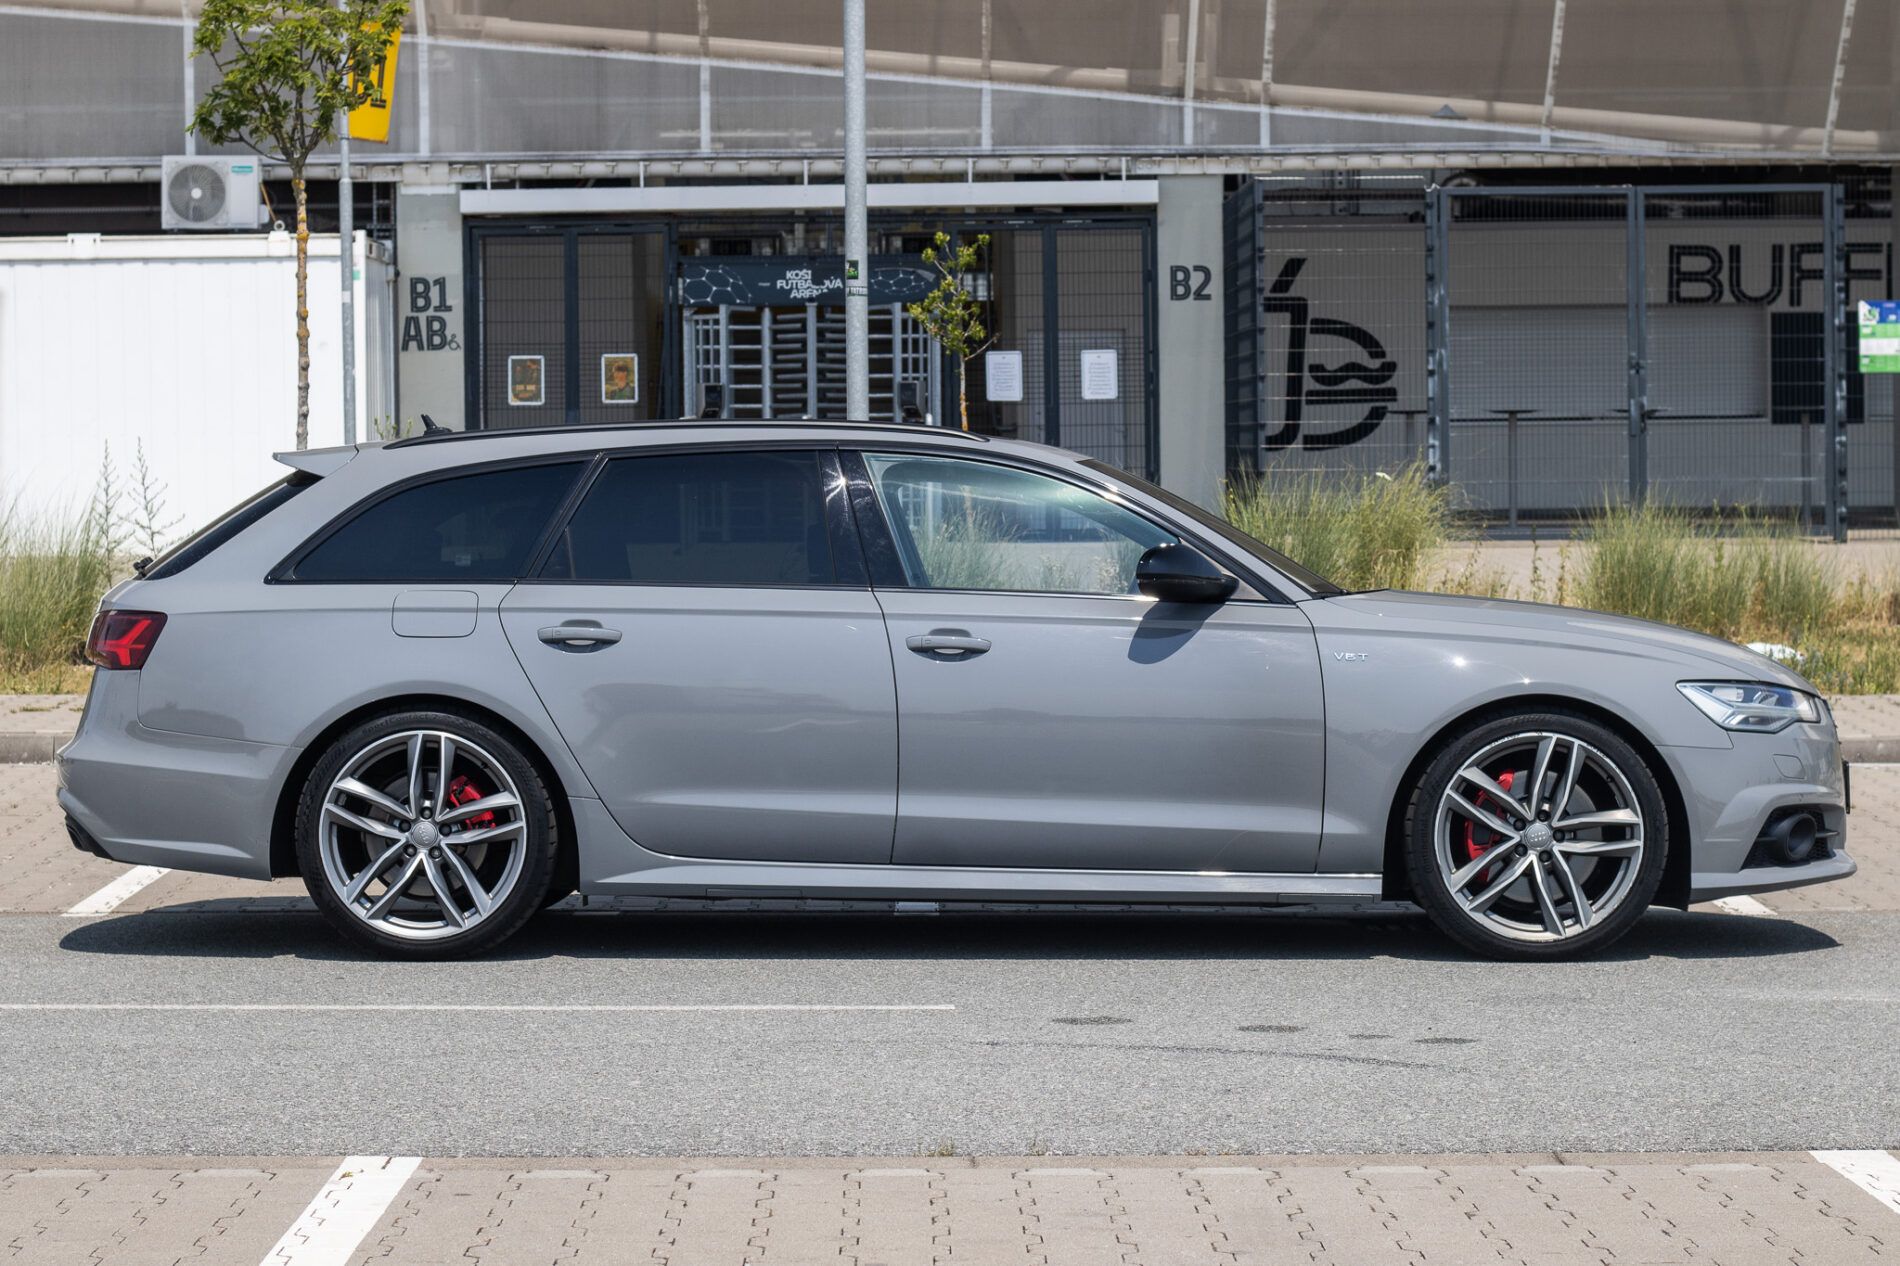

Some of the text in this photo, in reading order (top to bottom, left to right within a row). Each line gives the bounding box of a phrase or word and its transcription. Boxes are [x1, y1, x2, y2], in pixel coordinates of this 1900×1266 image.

[1170, 265, 1212, 301] B2
[1668, 242, 1893, 307] BUFF
[410, 276, 453, 312] B1
[401, 315, 448, 351] AB
